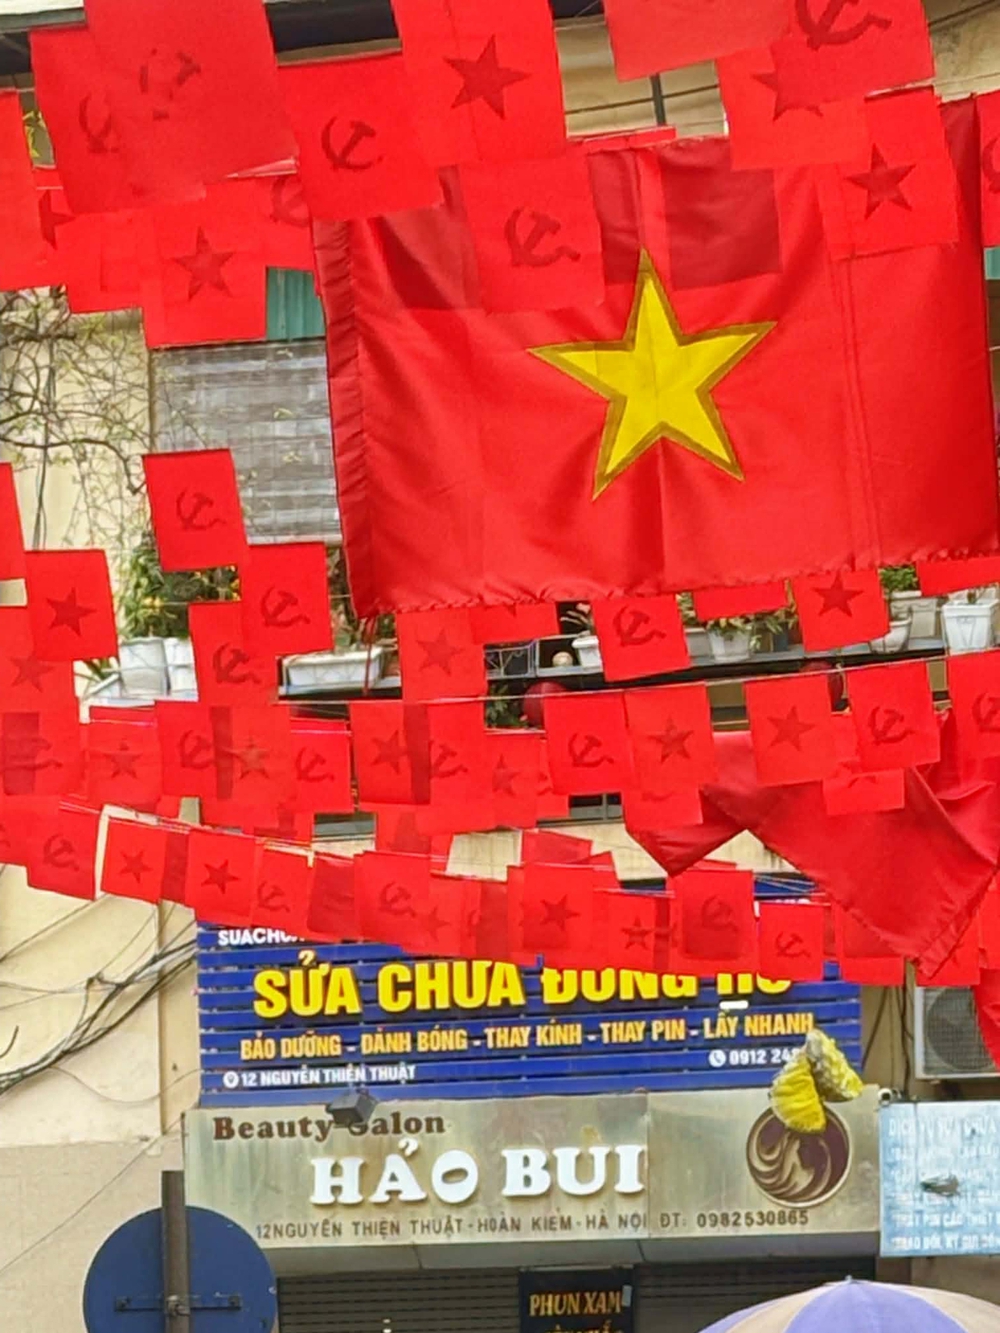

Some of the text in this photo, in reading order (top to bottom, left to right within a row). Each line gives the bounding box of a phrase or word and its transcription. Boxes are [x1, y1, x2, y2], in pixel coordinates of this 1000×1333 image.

[253, 950, 362, 1018] SỬA
[240, 1029, 276, 1061] BẢO
[417, 1024, 469, 1053] BÓNG
[484, 1026, 531, 1050] THAY
[536, 1017, 582, 1047] KÍNH
[599, 1019, 646, 1044] THAY
[652, 1018, 686, 1041] PIN
[744, 1012, 814, 1037] NHANH
[729, 1049, 767, 1066] 0912
[240, 1073, 257, 1088] 12
[213, 1115, 334, 1142] Beauty
[310, 1137, 646, 1204] HẢO BUI
[529, 1293, 580, 1316] PHUN
